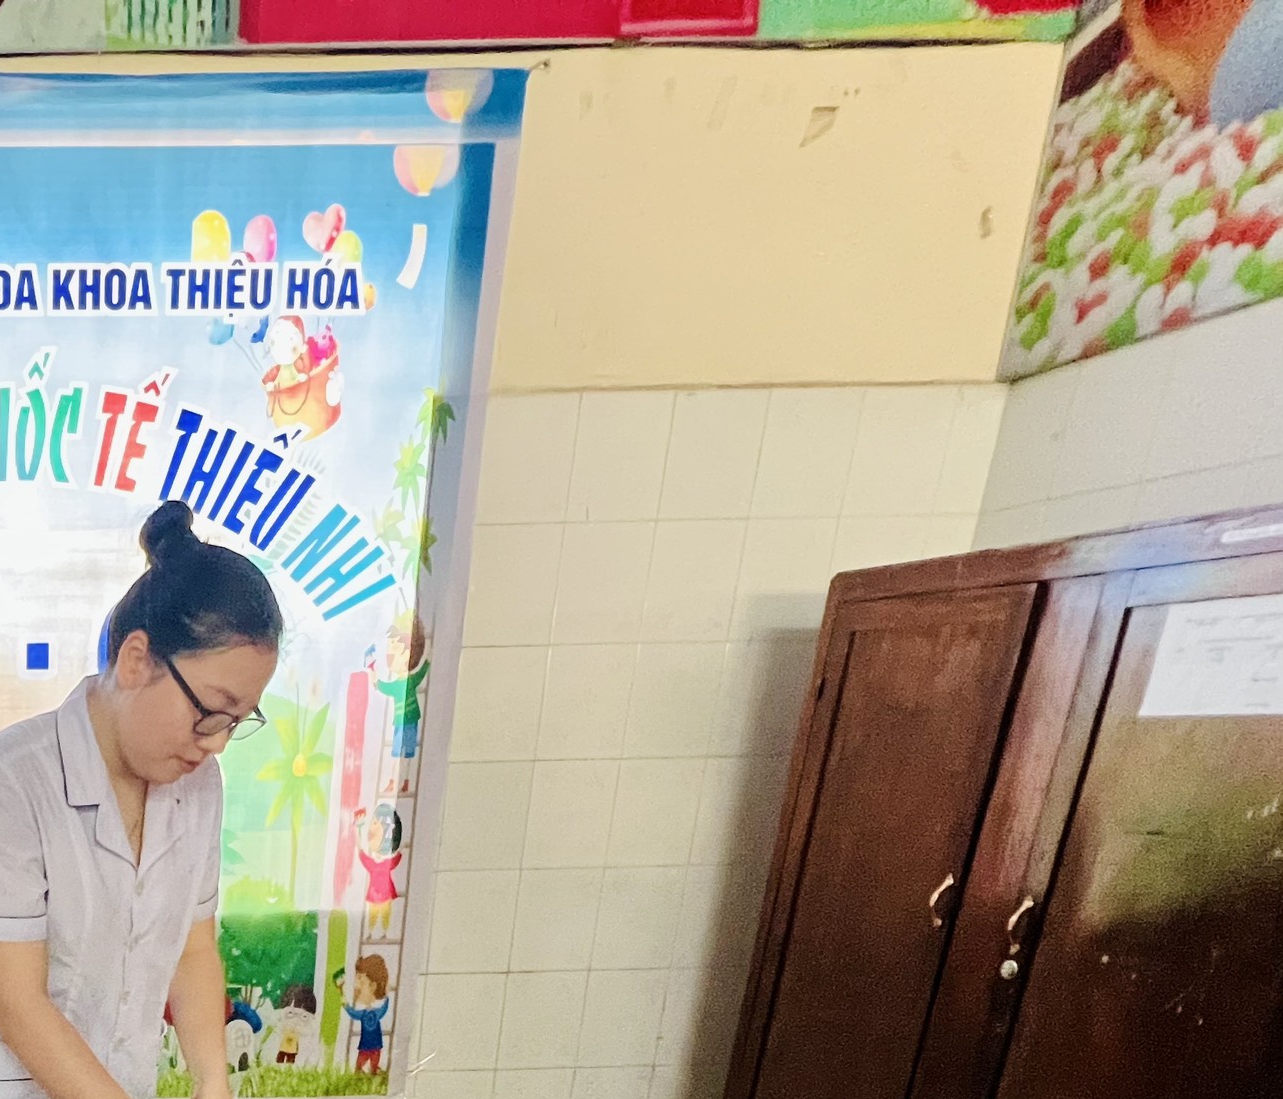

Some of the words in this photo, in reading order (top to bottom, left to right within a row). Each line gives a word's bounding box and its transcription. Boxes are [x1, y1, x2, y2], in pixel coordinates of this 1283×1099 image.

[52, 268, 153, 311] KHOA
[165, 259, 274, 318] THIỆU
[285, 258, 361, 311] HÓA
[93, 373, 171, 493] TẾ
[158, 408, 317, 552] THIẾU
[280, 503, 397, 622] NHI
